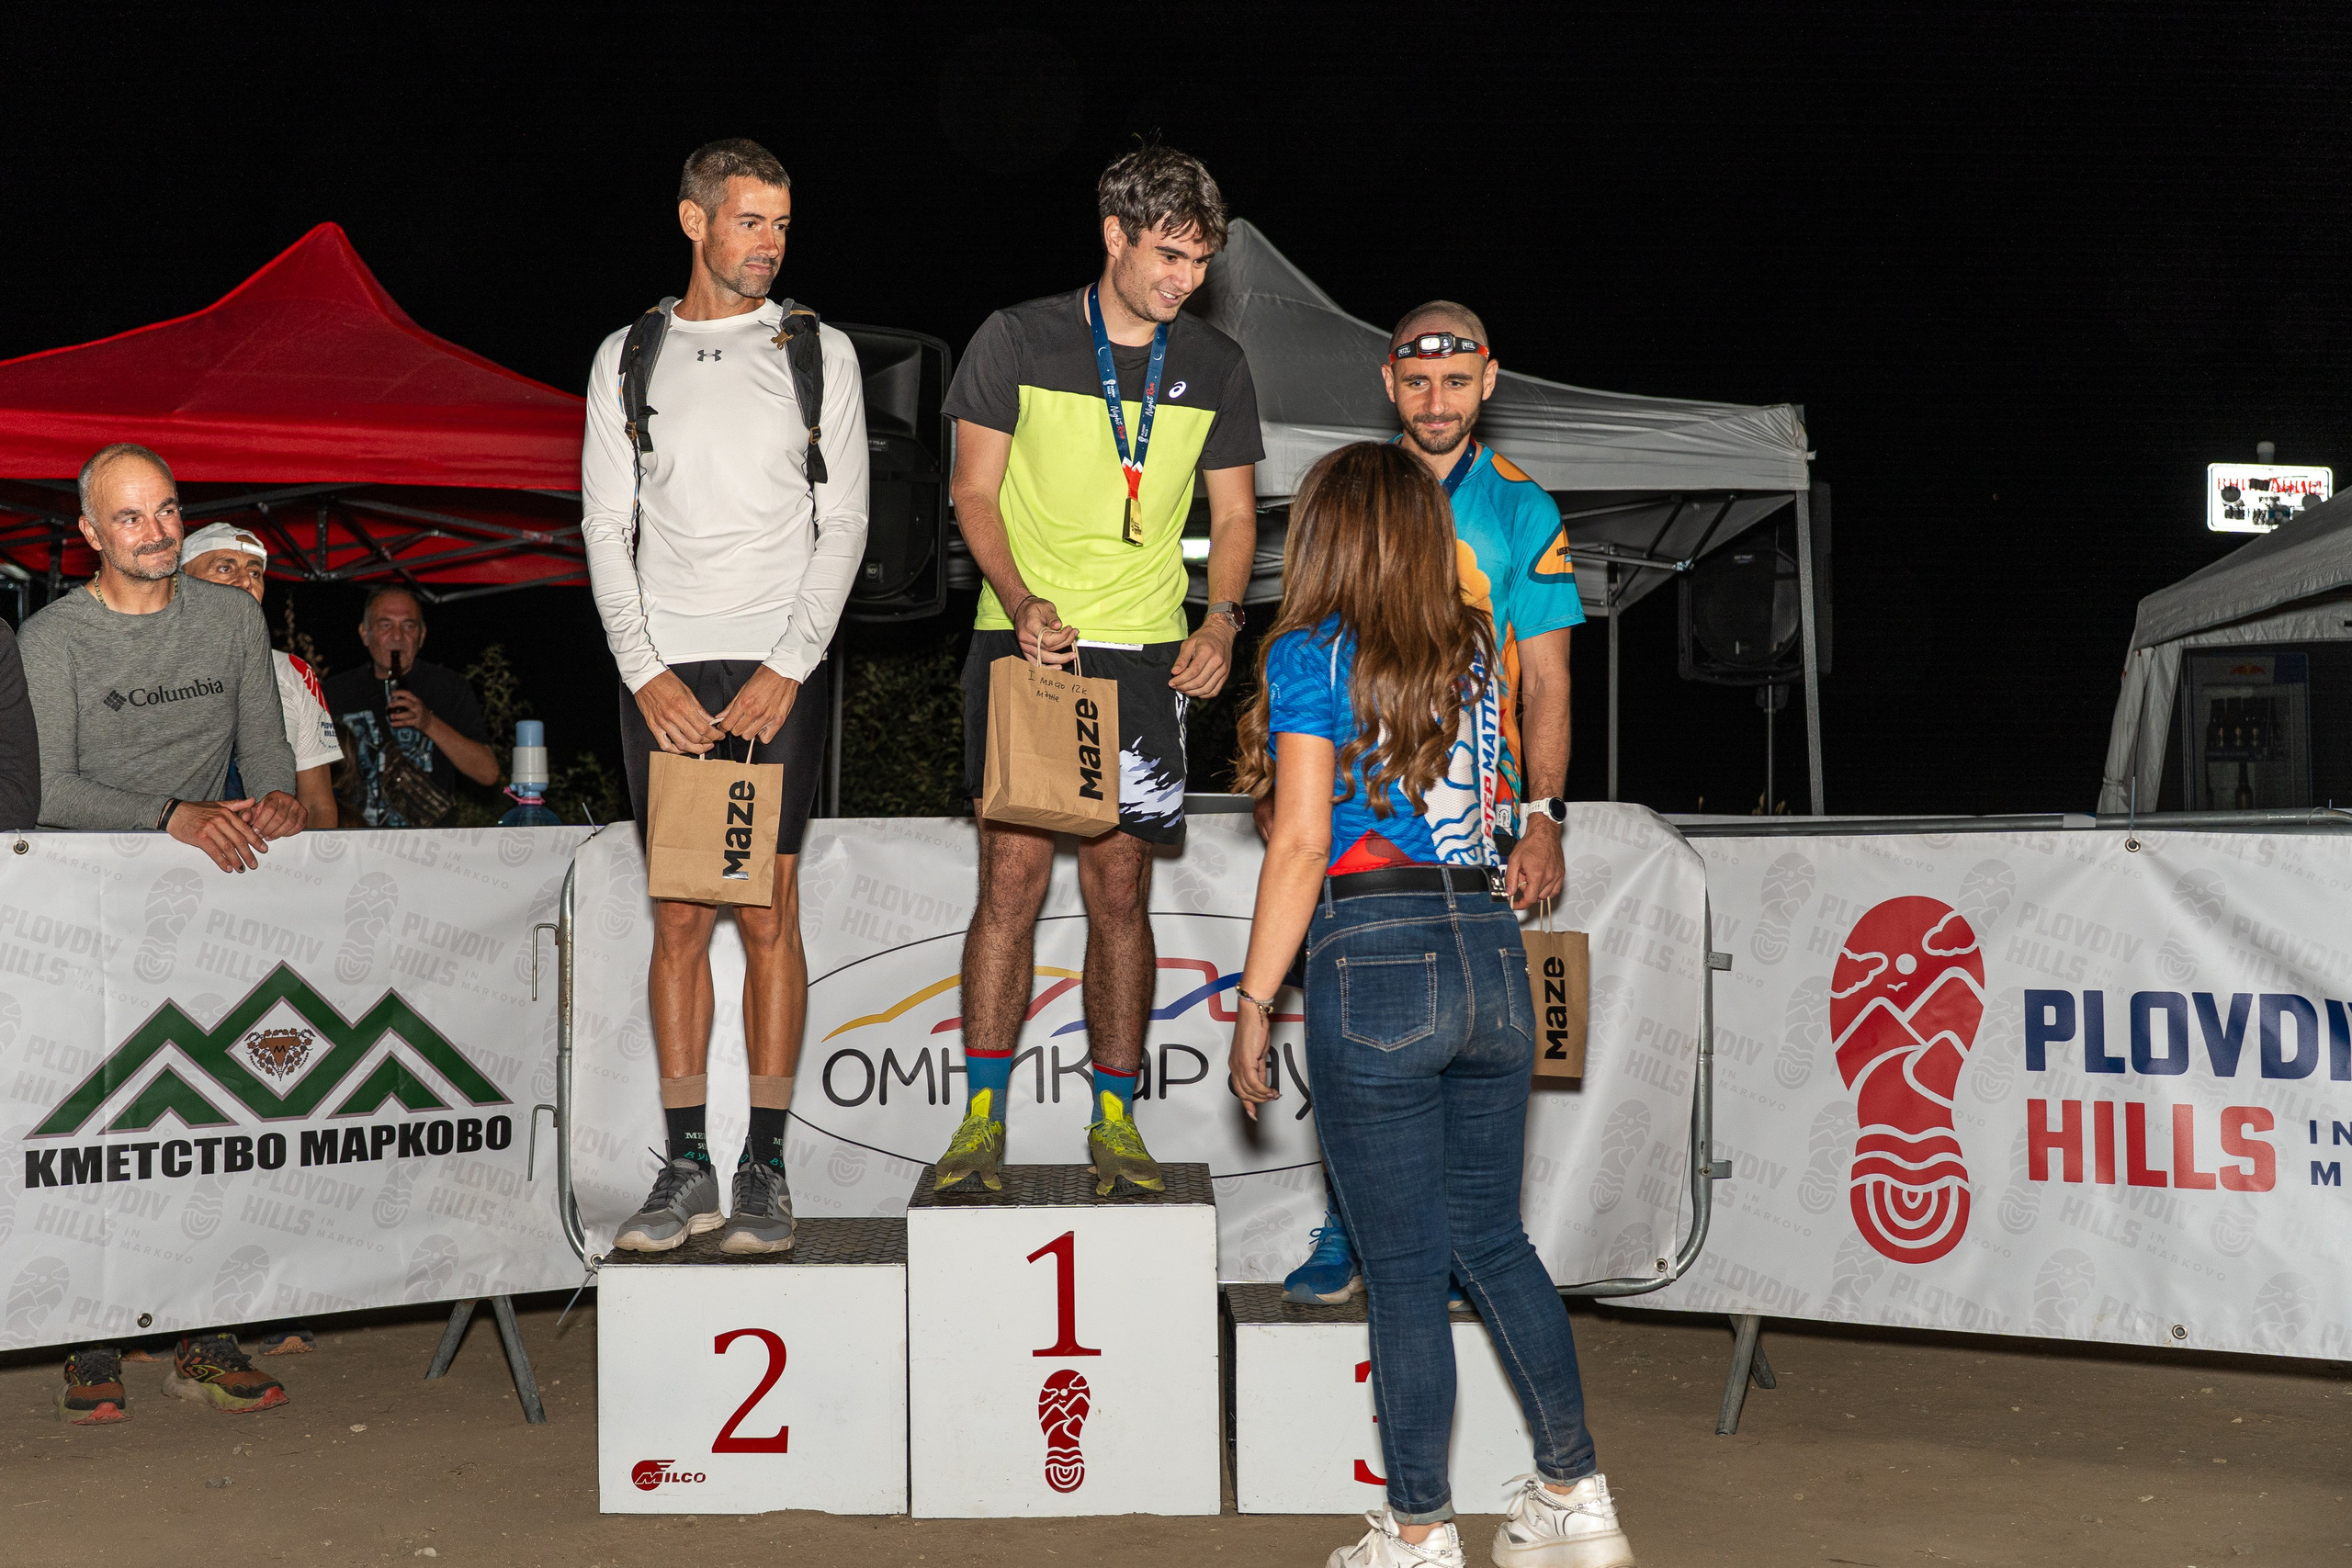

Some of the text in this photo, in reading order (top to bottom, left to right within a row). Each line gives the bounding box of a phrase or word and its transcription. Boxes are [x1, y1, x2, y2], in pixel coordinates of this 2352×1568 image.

[128, 677, 224, 707] Columbia
[1075, 697, 1103, 801] Maze
[1483, 774, 1495, 839] STEP
[1577, 806, 1654, 851] HILLS
[721, 780, 756, 880] Maze
[892, 826, 963, 852] MARKOVO
[45, 852, 124, 882] MARKOVO
[442, 862, 511, 890] MARKOVO
[1860, 843, 1935, 873] MARKOVO
[2064, 849, 2143, 879] MARKOVO
[849, 874, 963, 931] PLOVDIV
[205, 908, 324, 965] PLOVDIV
[401, 911, 506, 965] PLOVDIV
[839, 907, 915, 947] HILLS
[2018, 902, 2144, 964] PLOVDIV
[390, 944, 459, 987] HILLS
[1601, 926, 1675, 973] HILLS
[2005, 935, 2088, 984] HILLS
[73, 978, 152, 1010] MARKOVO
[460, 980, 527, 1009] MARKOVO
[1544, 956, 1567, 1060] Maze
[1623, 1049, 1689, 1097] HILLS
[1718, 1079, 1787, 1111] MARKOVO
[25, 1114, 513, 1189] КМЕТСТВО МАРКОВО
[2026, 1099, 2277, 1192] HILLS
[437, 1155, 542, 1203] PLOVDIV
[34, 1202, 117, 1247] HILLS
[241, 1194, 315, 1236] HILLS
[426, 1186, 498, 1226] HILLS
[1742, 1203, 1813, 1237] MARKOVO
[2059, 1194, 2143, 1250] HILLS
[120, 1240, 195, 1265] MARKOVO
[315, 1229, 385, 1253] MARKOVO
[499, 1220, 564, 1244] MARKOVO
[1698, 1250, 1810, 1317] PLOVDIV
[2146, 1244, 2226, 1281] MARKOVO
[1026, 1231, 1102, 1358] 1
[711, 1327, 789, 1454] 2
[635, 1472, 707, 1484] MILCO
[1448, 1524, 1457, 1547] KARL
